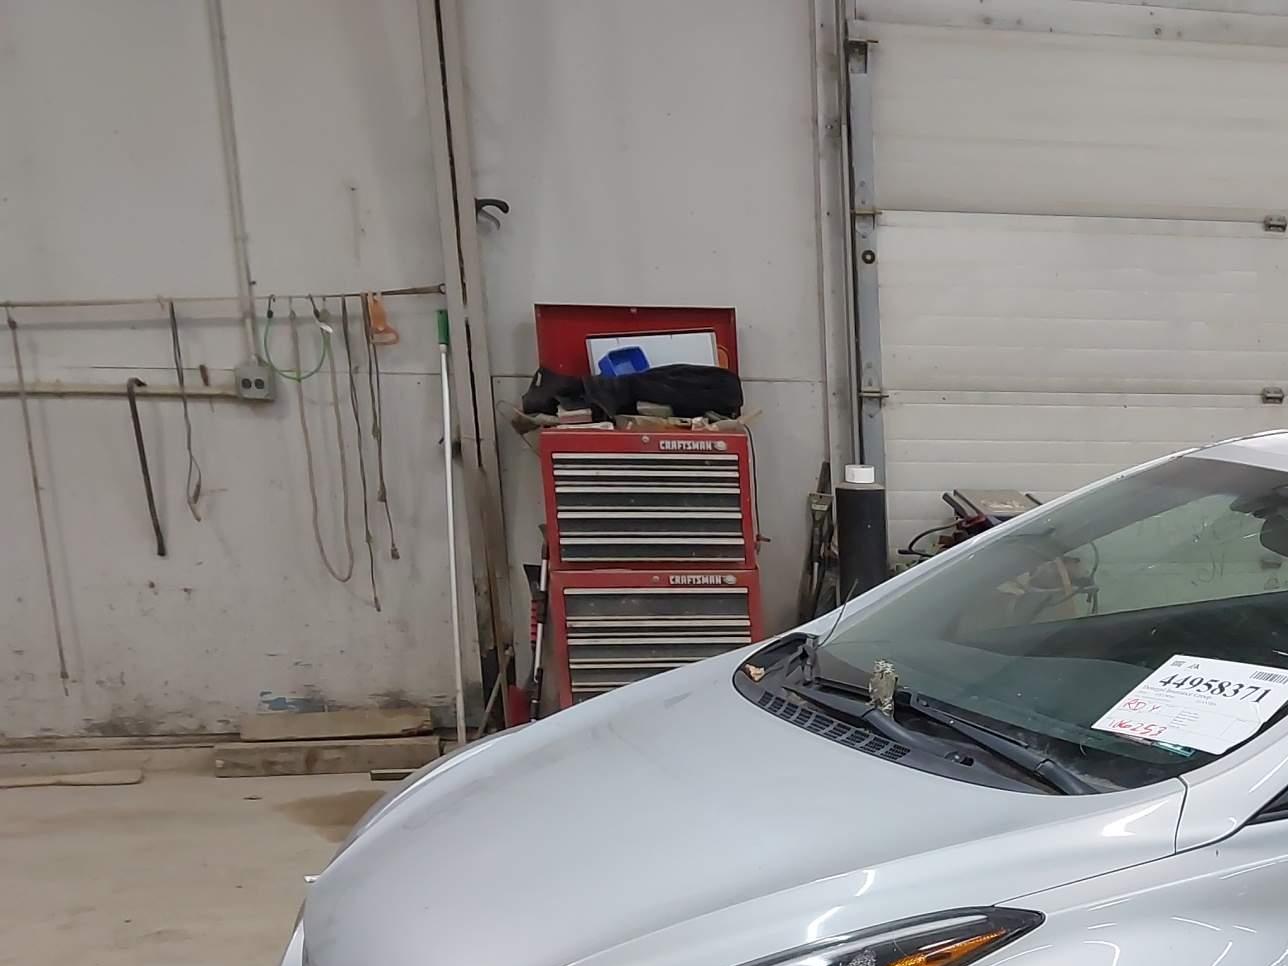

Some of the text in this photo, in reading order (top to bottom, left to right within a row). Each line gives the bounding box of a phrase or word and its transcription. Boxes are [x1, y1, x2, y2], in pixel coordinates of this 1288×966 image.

[659, 440, 713, 451] CRAFTSMAN
[669, 575, 722, 586] CRAFTSMAN
[1159, 673, 1272, 703] 44958371
